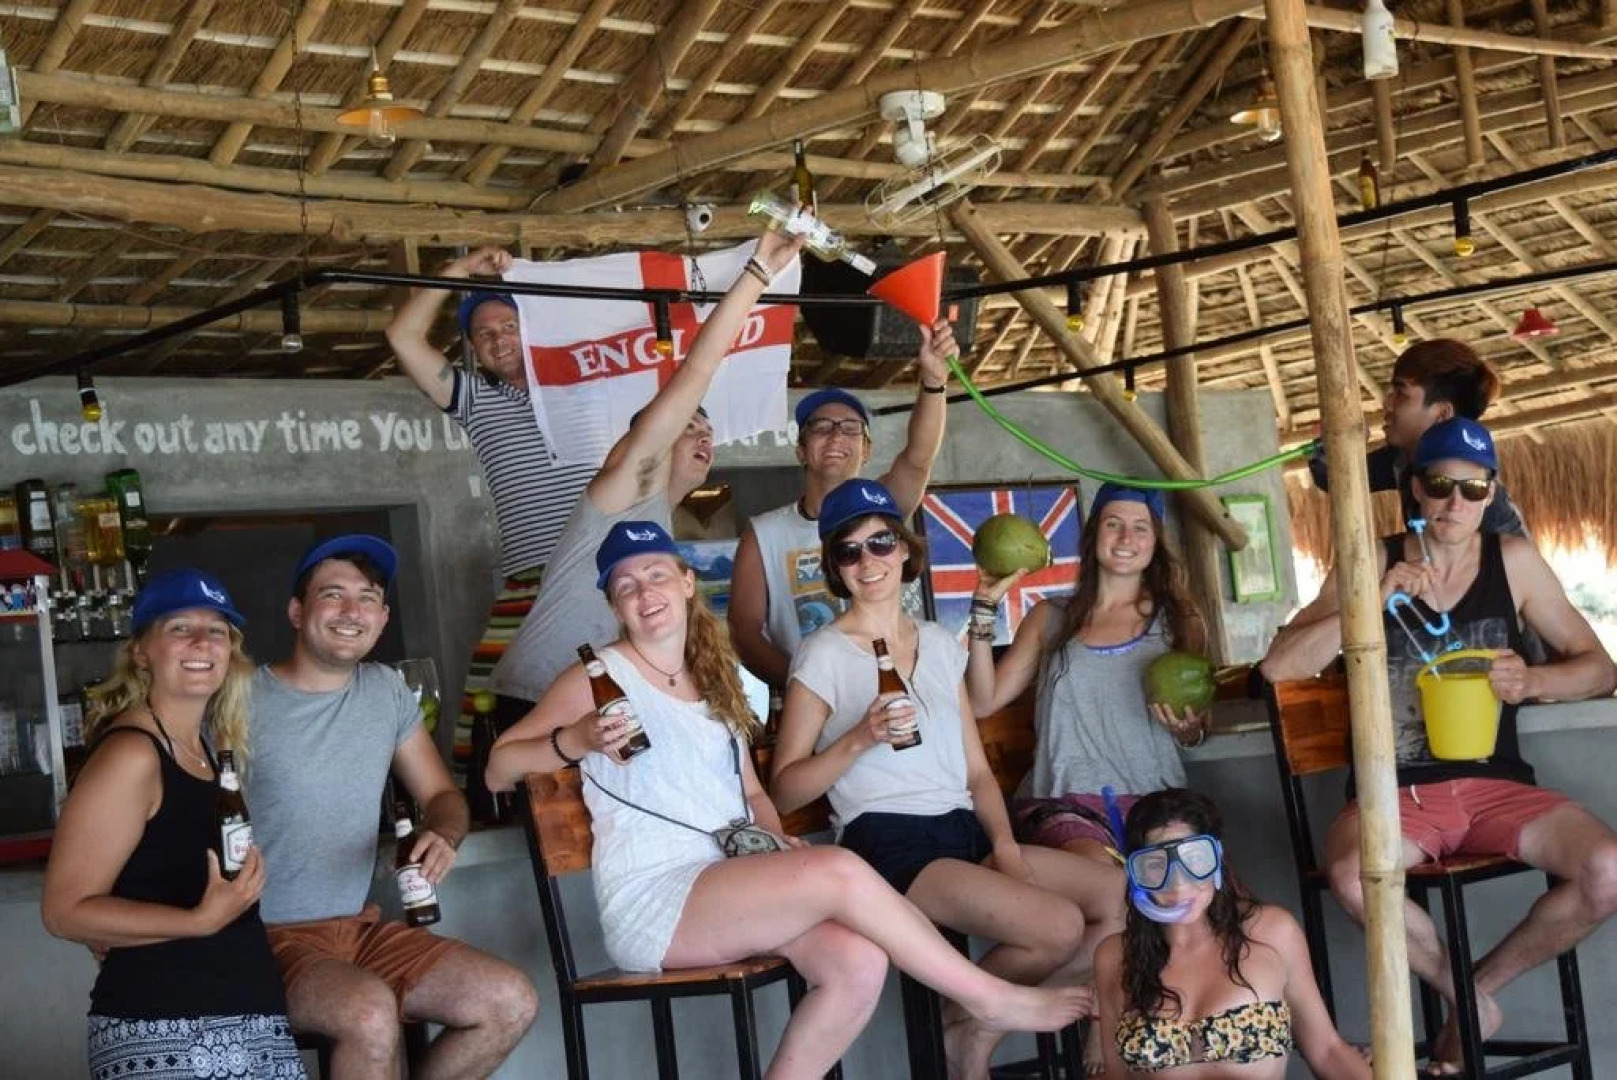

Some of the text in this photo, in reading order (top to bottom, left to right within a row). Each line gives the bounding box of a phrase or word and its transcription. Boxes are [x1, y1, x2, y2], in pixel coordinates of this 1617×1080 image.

[570, 314, 765, 378] ENGLD
[11, 399, 128, 455] check
[134, 413, 200, 454] out
[203, 419, 269, 454] any
[275, 409, 363, 454] time
